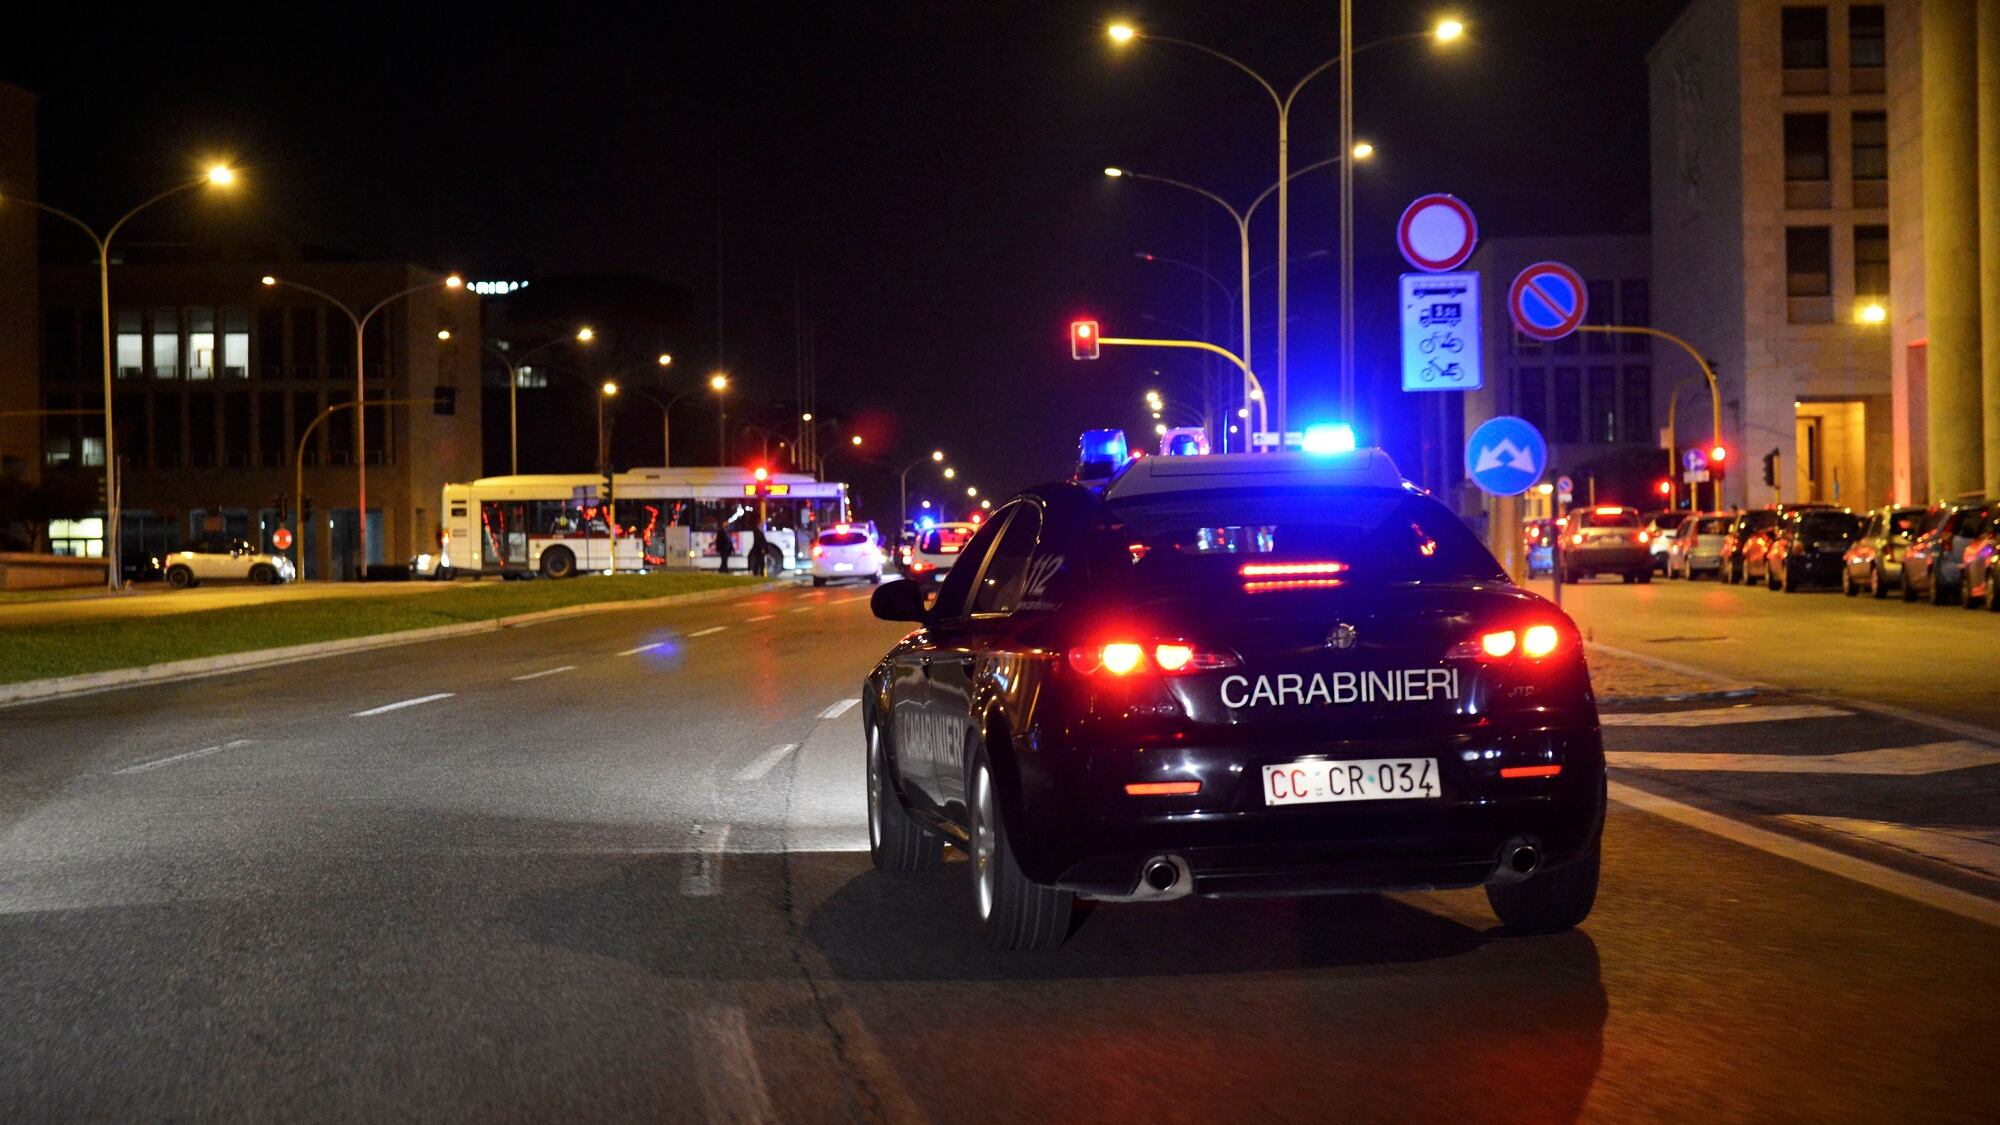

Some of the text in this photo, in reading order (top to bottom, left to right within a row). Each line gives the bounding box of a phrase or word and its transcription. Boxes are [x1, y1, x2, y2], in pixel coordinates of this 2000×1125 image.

[1024, 553, 1065, 596] 112
[1220, 667, 1459, 709] CARABINIERI
[1270, 761, 1433, 799] CC CR 034
